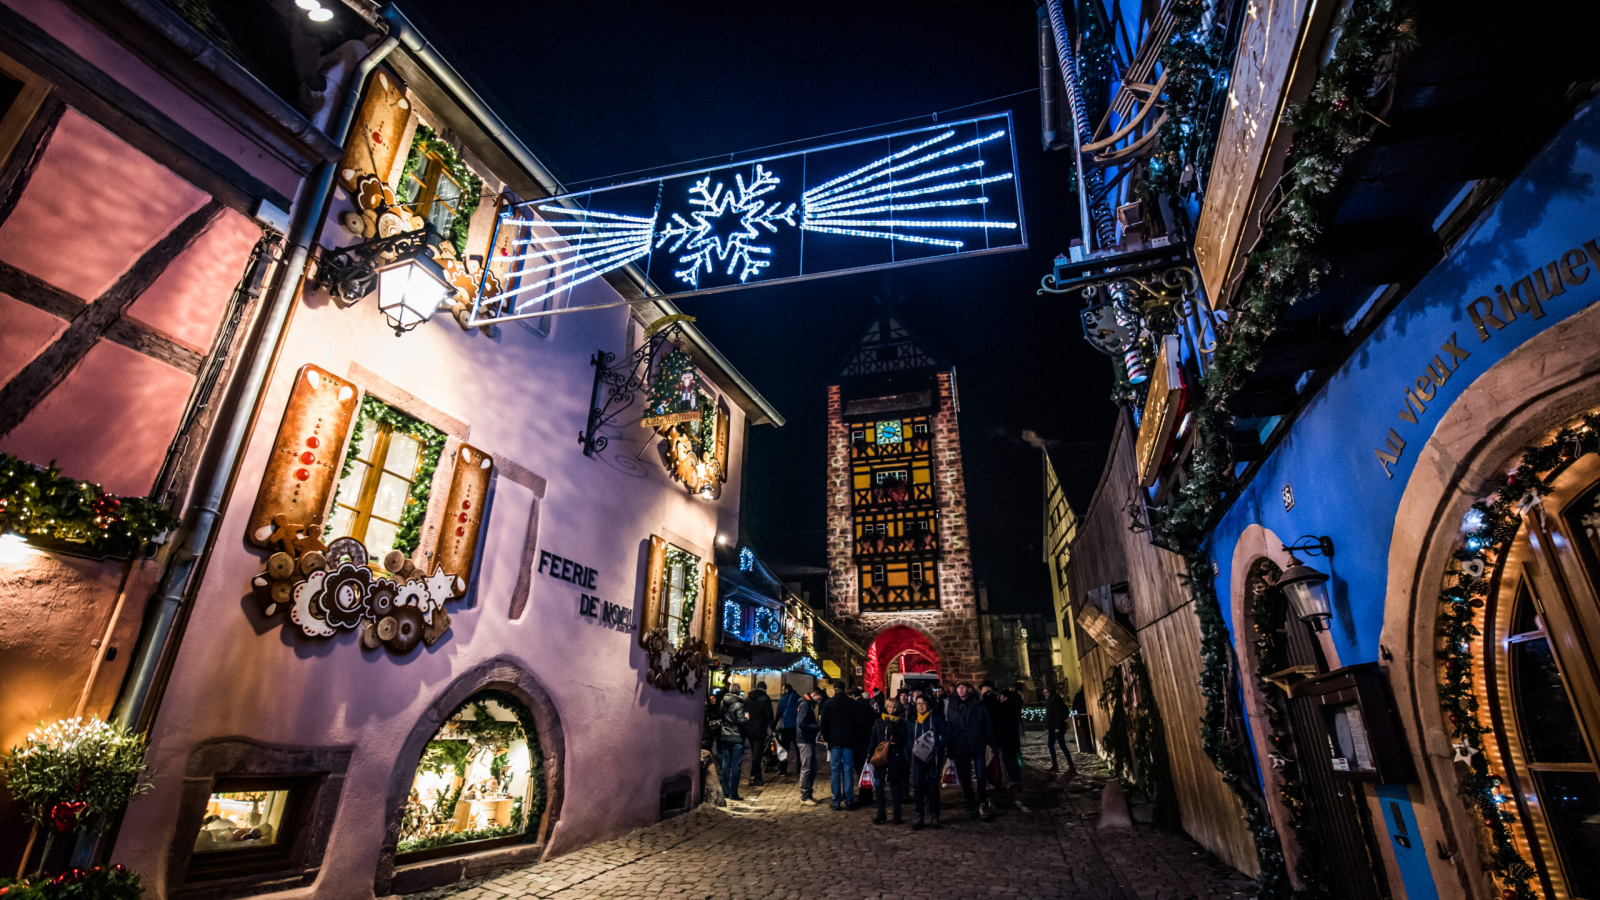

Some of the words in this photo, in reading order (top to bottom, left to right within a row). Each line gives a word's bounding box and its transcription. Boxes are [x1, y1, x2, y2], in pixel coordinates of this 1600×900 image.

[1374, 427, 1407, 480] Au
[1398, 331, 1472, 425] vieux
[1282, 487, 1292, 507] 56
[537, 548, 599, 591] FEERIE
[579, 593, 600, 619] DE
